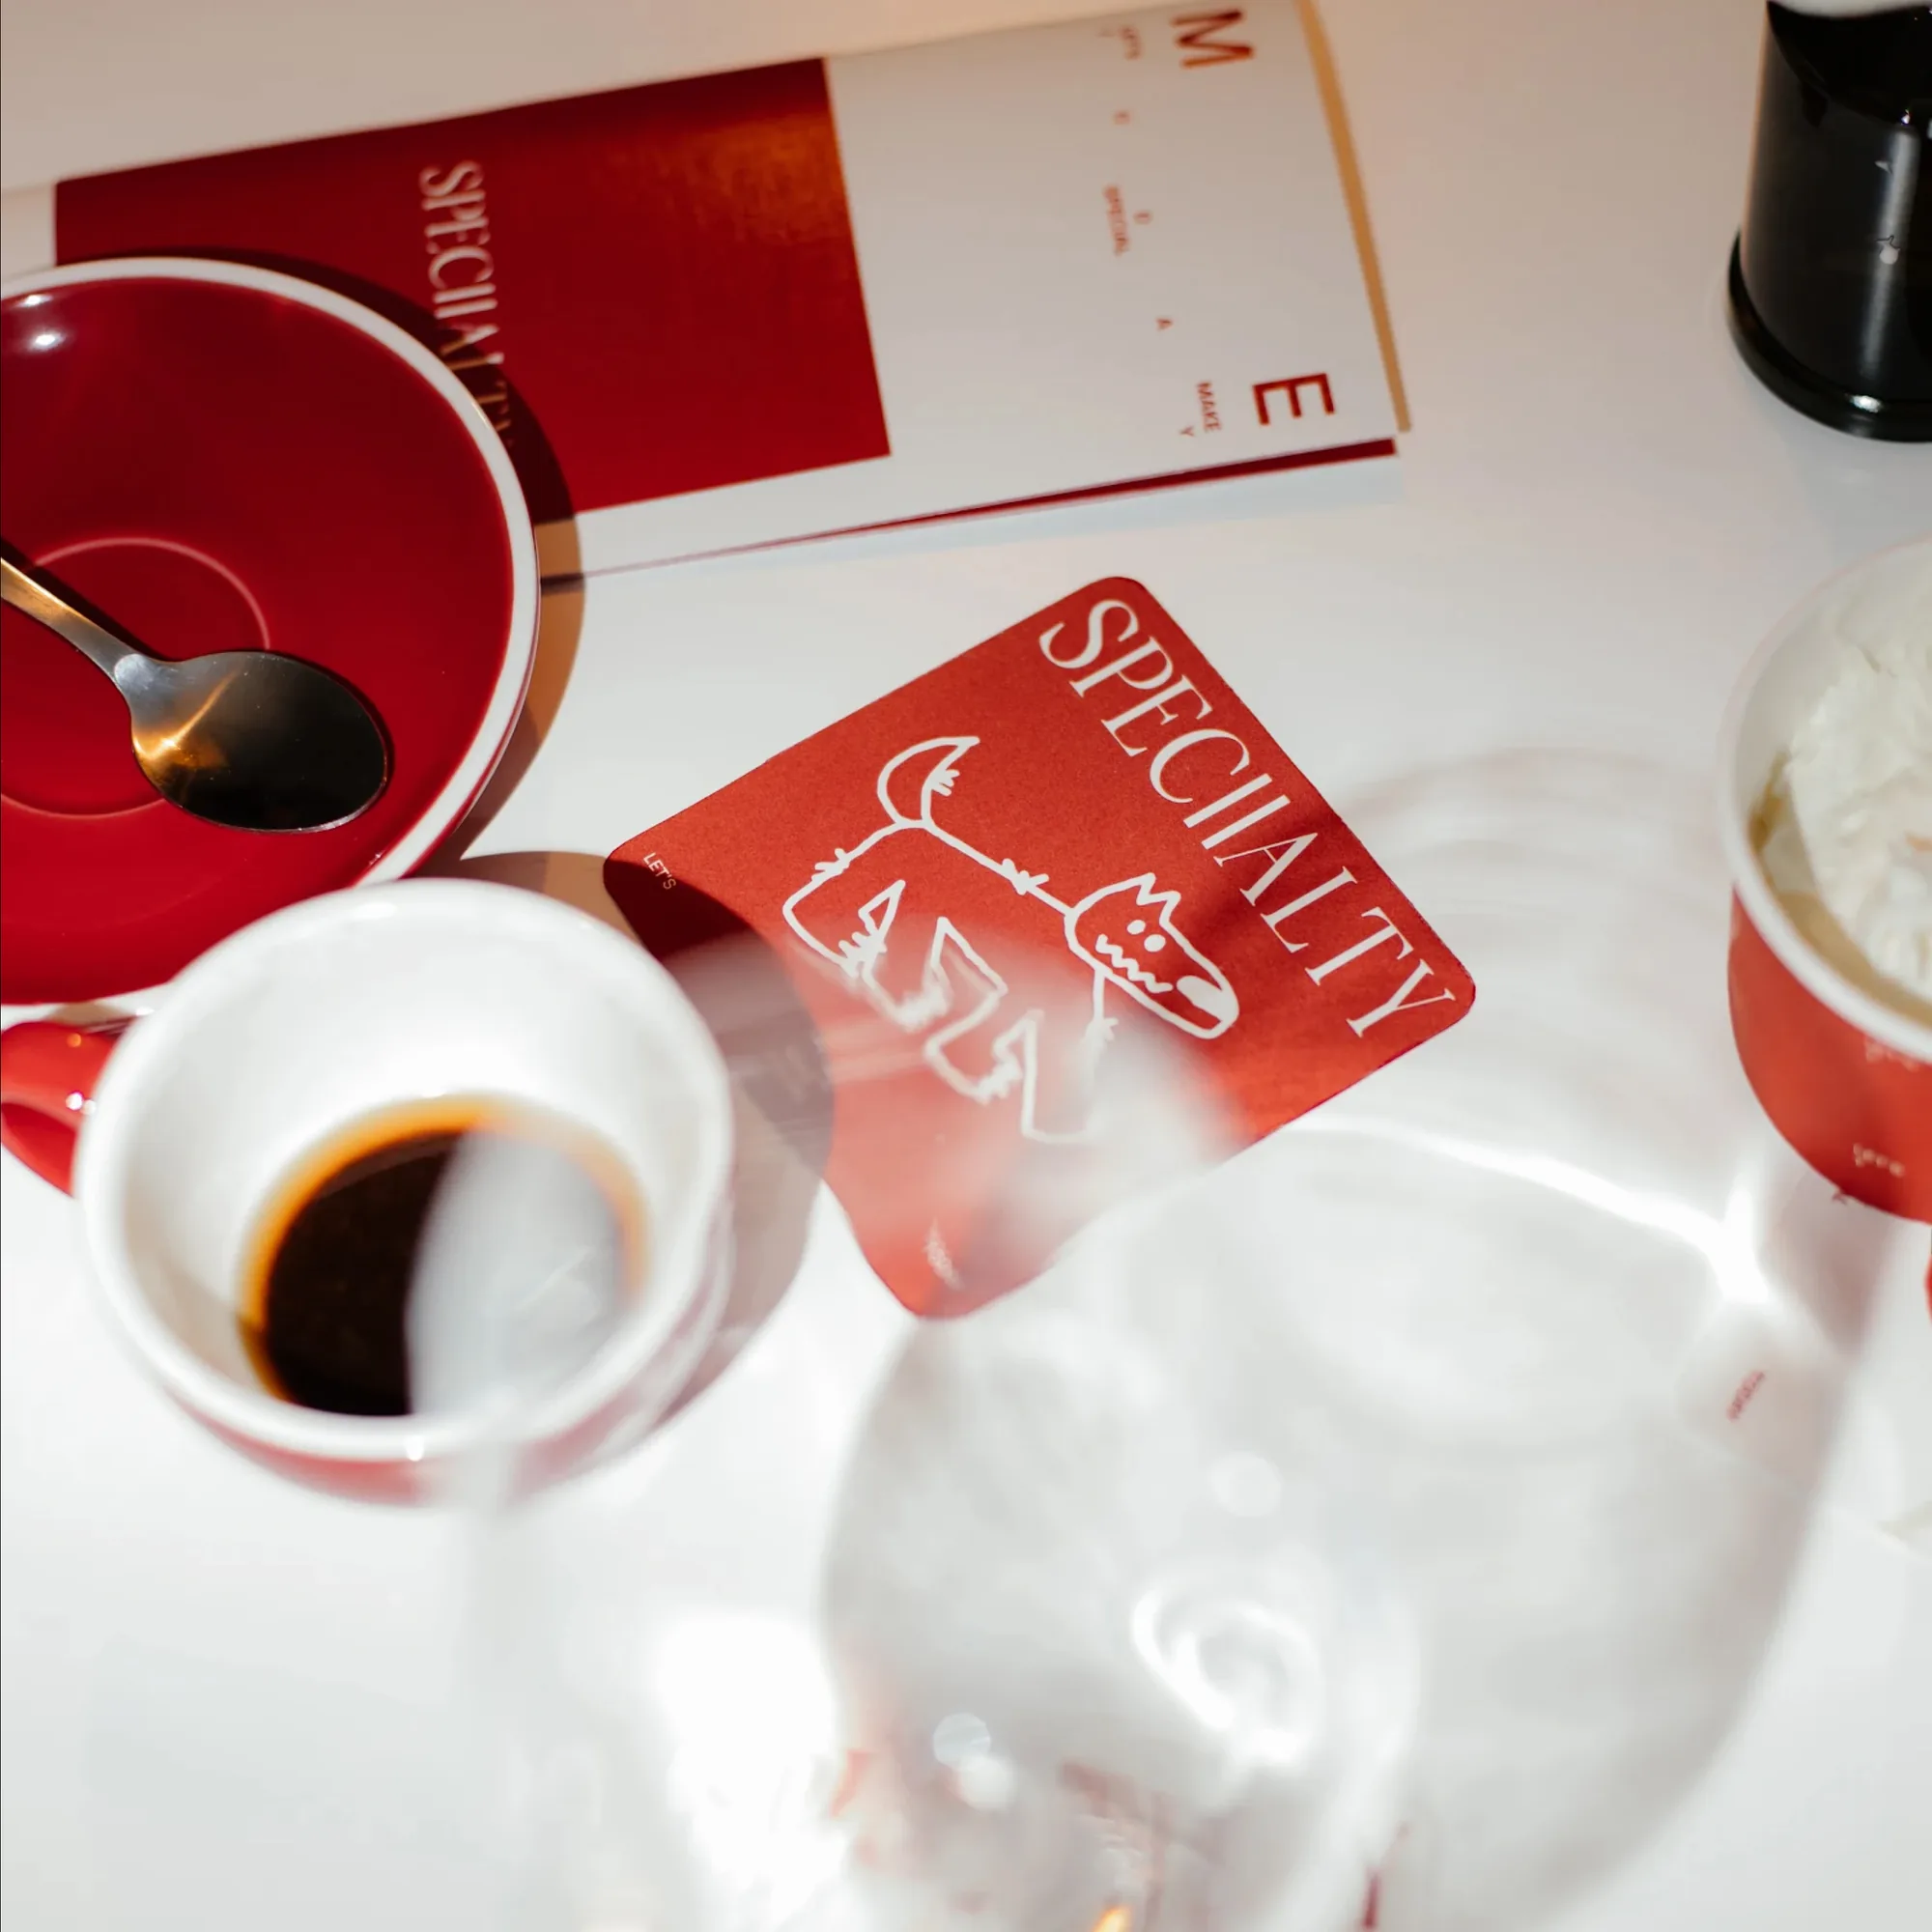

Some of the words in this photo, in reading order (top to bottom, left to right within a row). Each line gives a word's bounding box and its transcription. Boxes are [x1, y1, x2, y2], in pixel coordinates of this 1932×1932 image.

[1171, 11, 1253, 69] M
[1197, 383, 1221, 432] MAKE
[1253, 373, 1335, 425] E
[642, 852, 676, 890] LET'S
